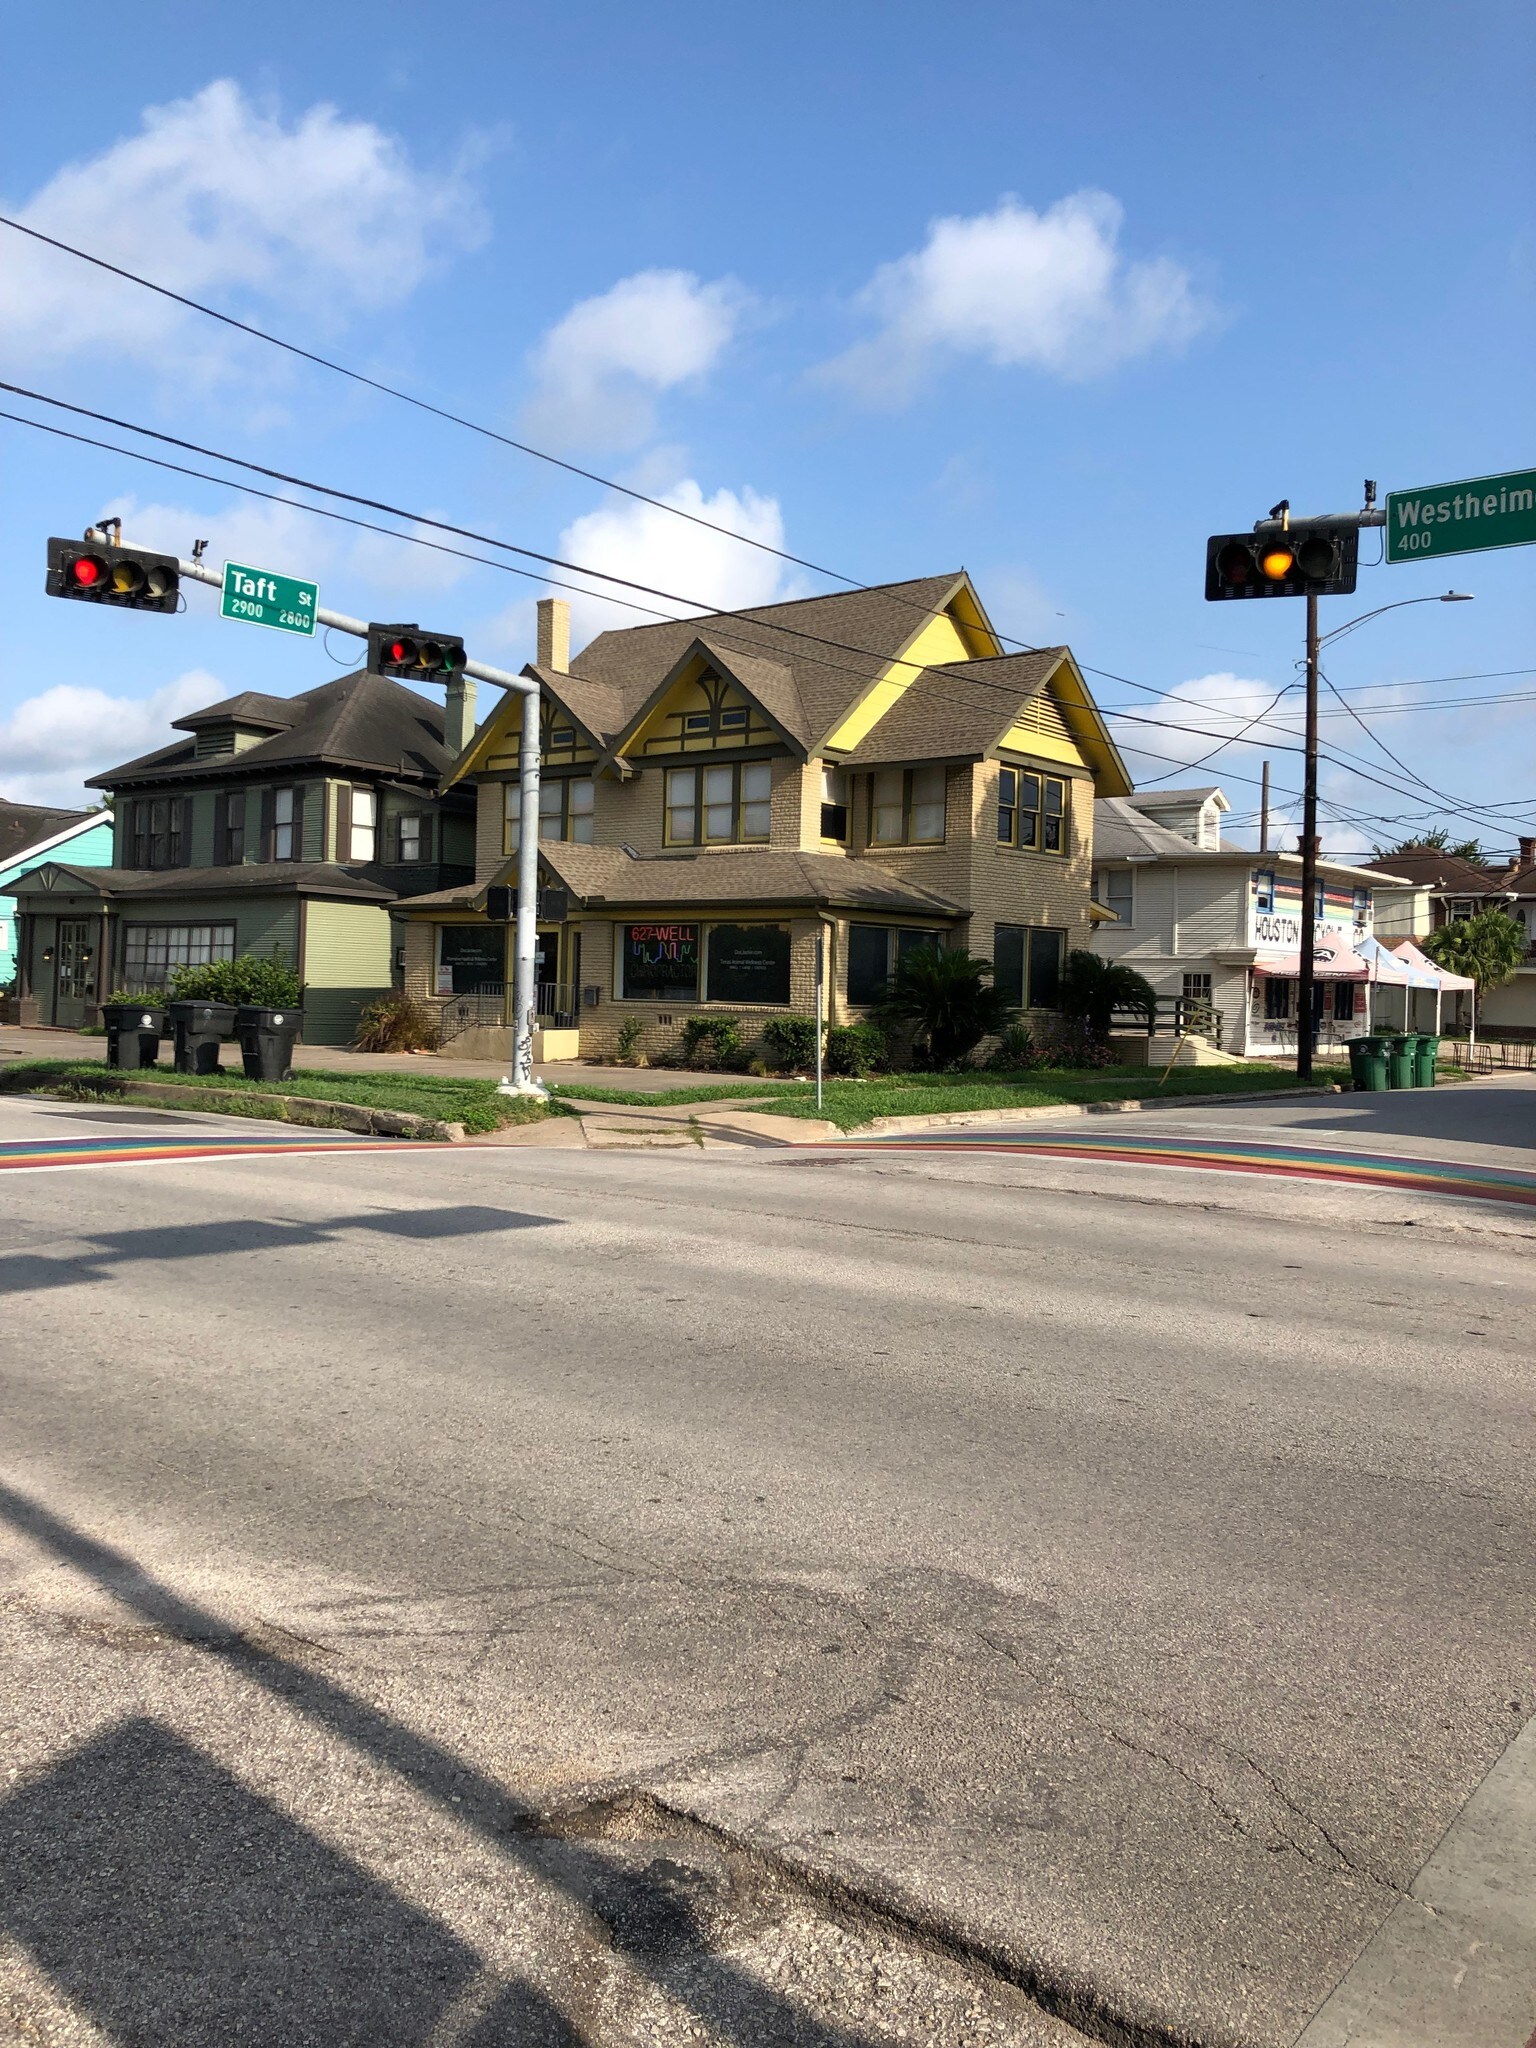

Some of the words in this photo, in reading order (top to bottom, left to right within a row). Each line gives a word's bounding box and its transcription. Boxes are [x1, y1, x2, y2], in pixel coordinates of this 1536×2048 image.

[1397, 486, 1536, 528] Westheim
[1397, 531, 1431, 551] 400
[231, 570, 277, 601] Taft
[298, 591, 312, 607] St
[231, 598, 263, 618] 2900
[279, 609, 310, 629] 2800
[631, 925, 695, 941] 627-WELL
[1255, 916, 1299, 944] HOUSTON
